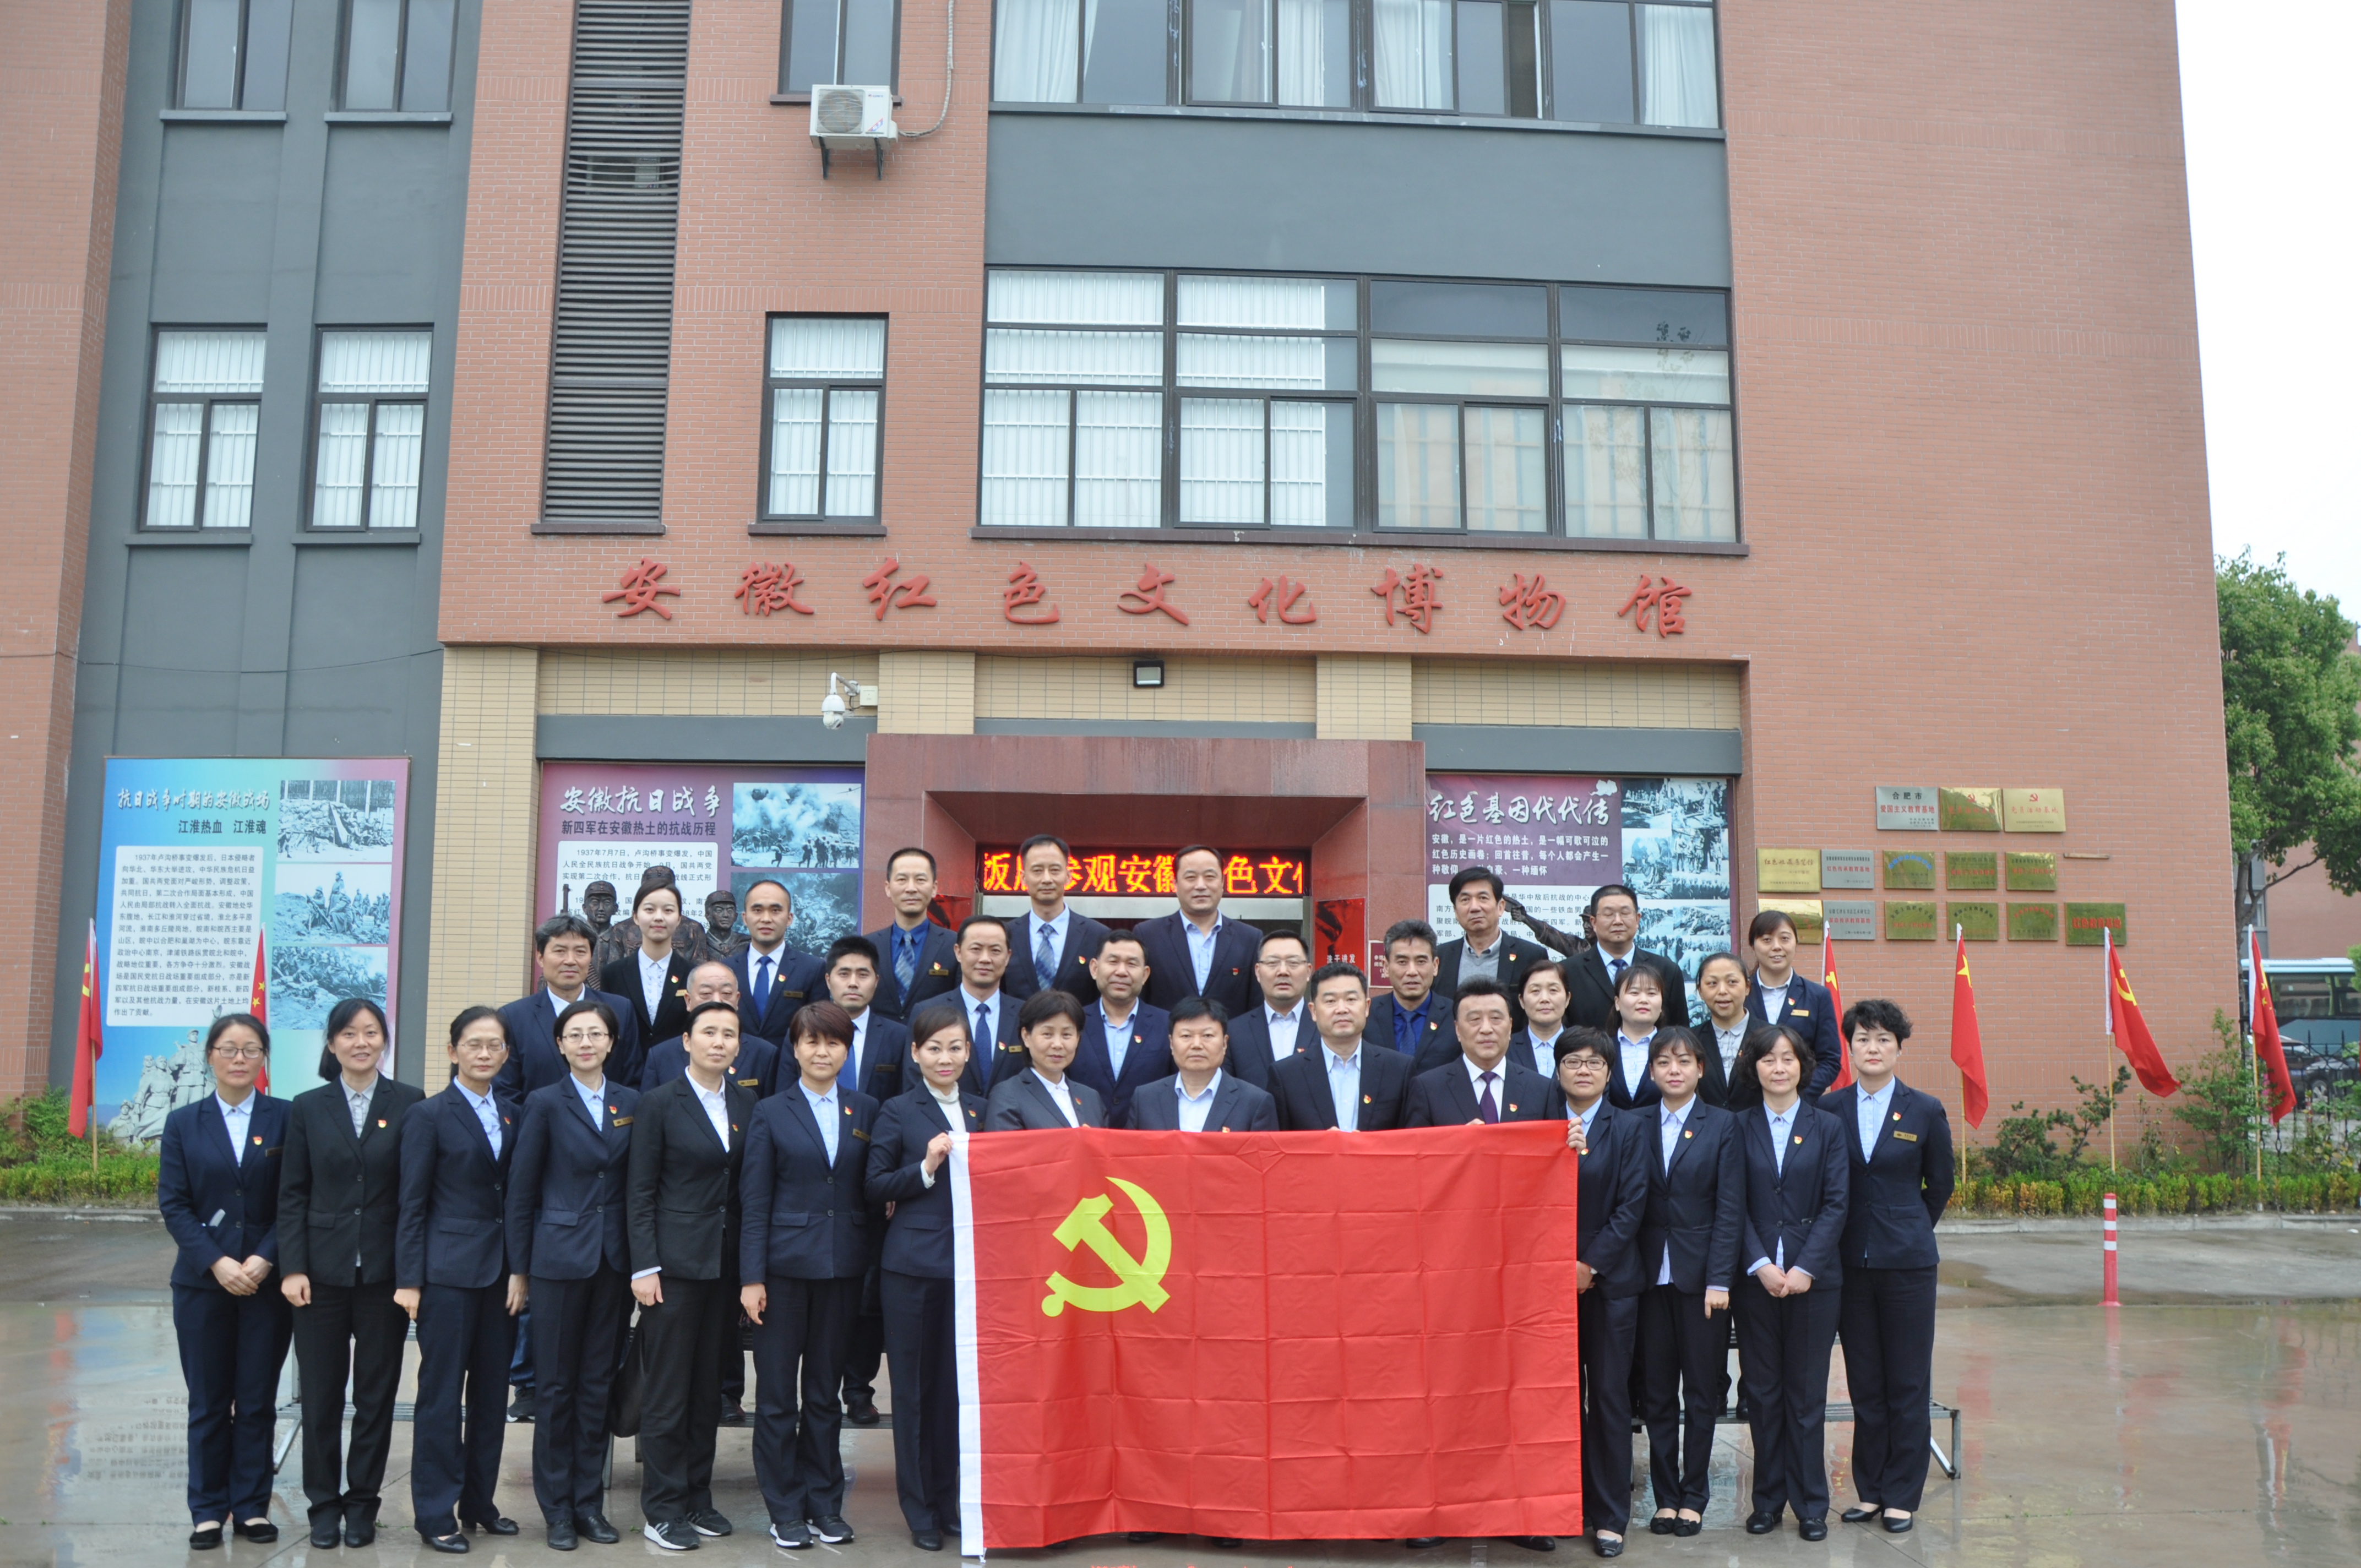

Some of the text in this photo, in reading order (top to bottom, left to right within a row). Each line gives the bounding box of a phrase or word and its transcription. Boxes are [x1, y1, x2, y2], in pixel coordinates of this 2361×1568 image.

[602, 557, 1692, 638] 安徽红色文化博物馆
[118, 788, 270, 810] 抗日战争时期的安徽战场
[560, 785, 720, 817] 安徽抗日战争
[1892, 792, 1922, 800] 合肥市
[1429, 792, 1610, 825] 红色基因代代传
[1880, 804, 1935, 813] 爱国主义教育基地
[179, 819, 266, 834] 江淮热血 江淮魂
[561, 820, 716, 836] 新四军在安徽热土的抗战历程
[1432, 834, 1608, 846] 安徽，是一片红色的热土，是一幅可歌可泣的
[1432, 848, 1608, 861] 红色历史画卷；回首往昔，每个人都会产生一
